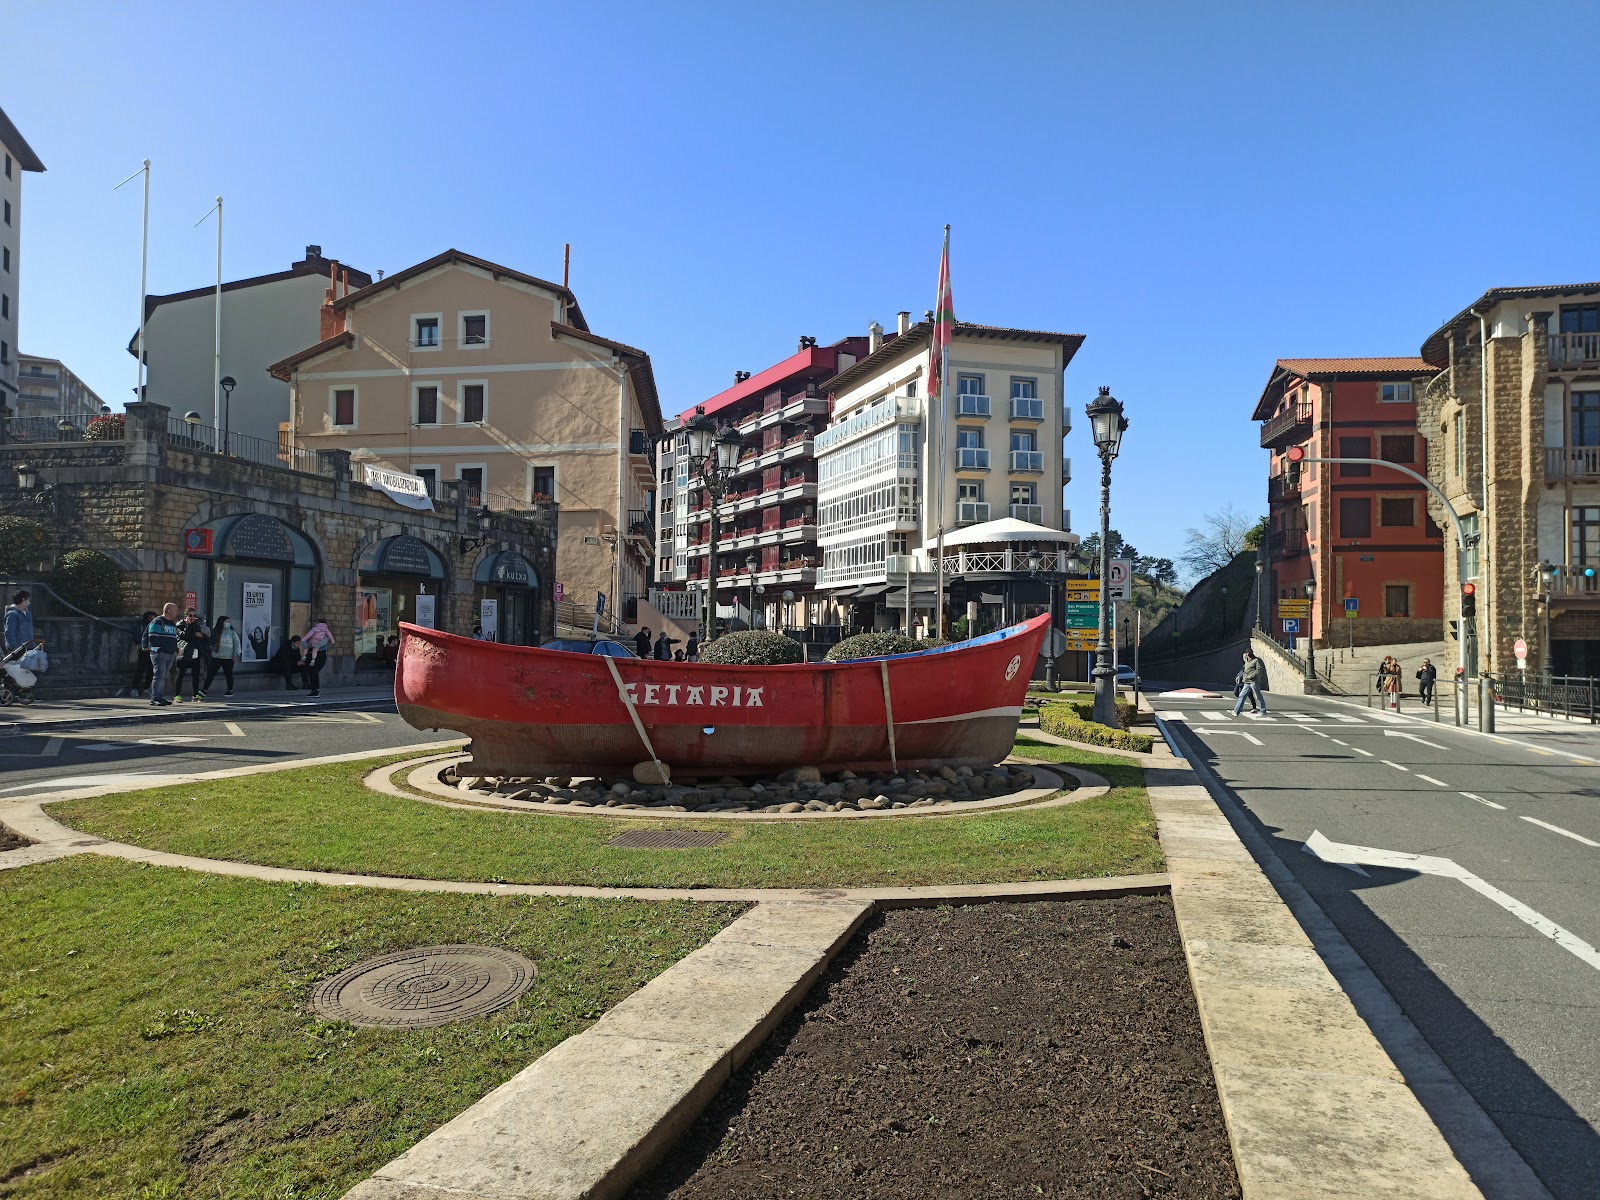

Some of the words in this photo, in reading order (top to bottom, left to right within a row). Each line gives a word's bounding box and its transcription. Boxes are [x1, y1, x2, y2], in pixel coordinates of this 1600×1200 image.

[217, 566, 224, 580] k
[506, 568, 527, 581] kutxa
[420, 582, 426, 595] k
[1286, 620, 1296, 631] P
[619, 683, 764, 707] GETARIA
